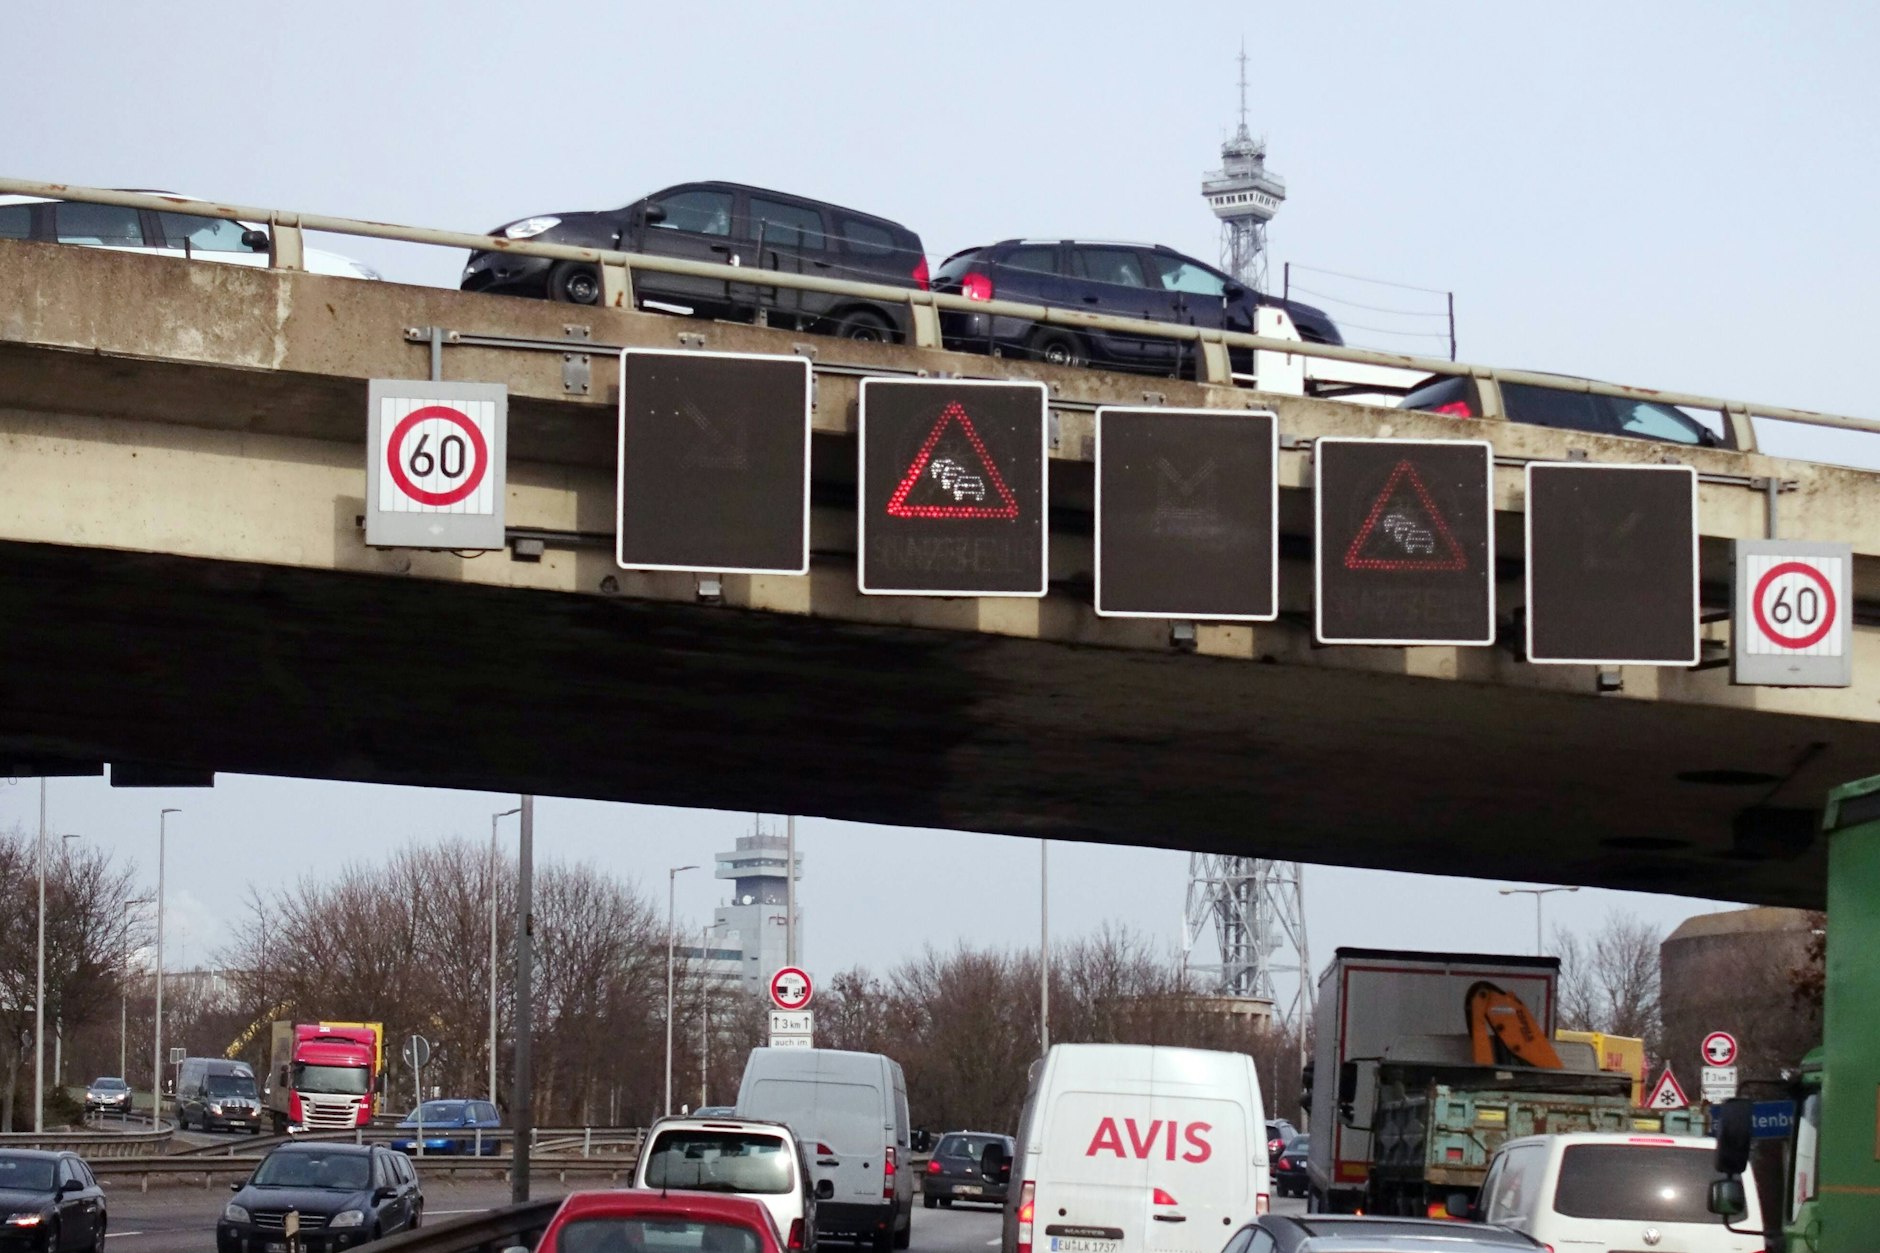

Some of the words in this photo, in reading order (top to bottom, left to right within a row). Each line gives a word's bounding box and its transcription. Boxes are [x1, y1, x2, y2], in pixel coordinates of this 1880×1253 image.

[409, 433, 465, 478] 60
[1772, 586, 1817, 625] 60
[774, 1039, 795, 1047] auch
[797, 1039, 808, 1047] im
[782, 1019, 788, 1029] 3
[790, 1020, 801, 1029] km
[1085, 1117, 1213, 1163] AVIS
